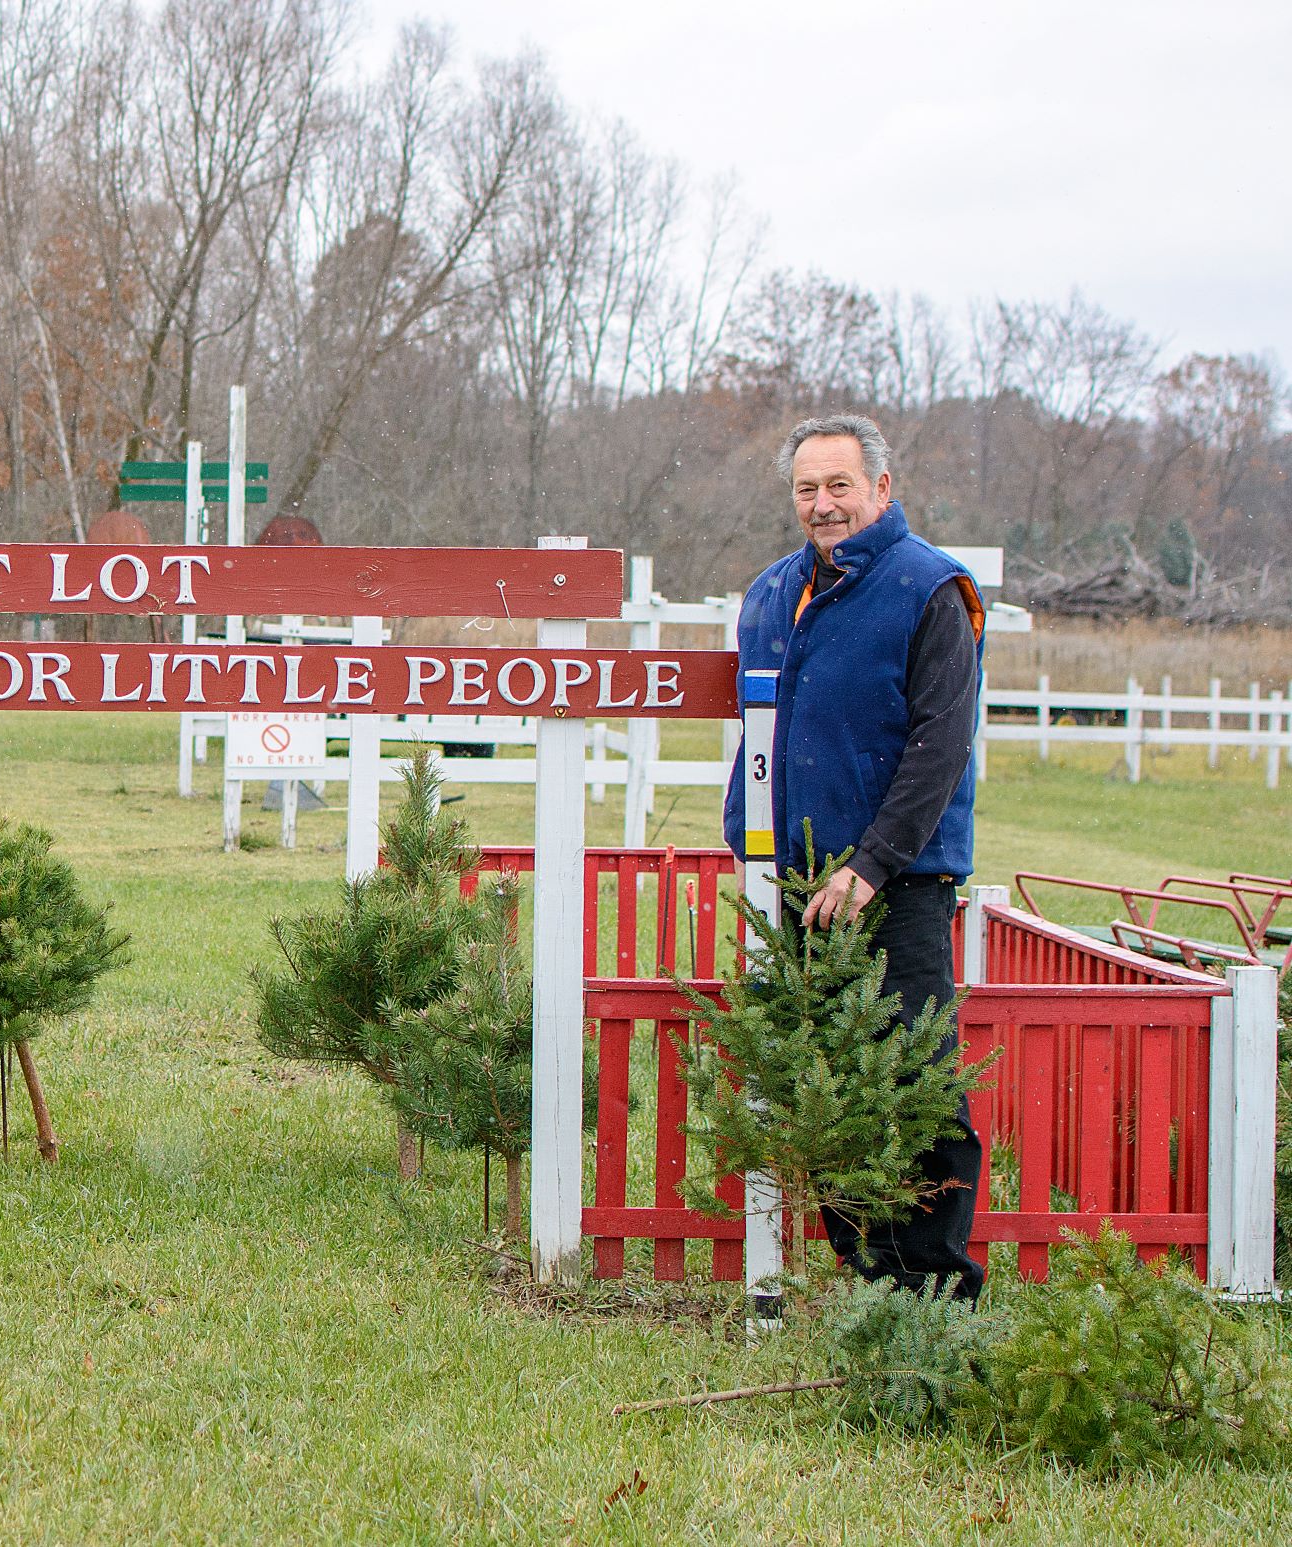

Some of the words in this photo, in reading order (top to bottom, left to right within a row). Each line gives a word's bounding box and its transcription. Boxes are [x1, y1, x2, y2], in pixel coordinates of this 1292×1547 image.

[49, 553, 211, 606] LOT
[99, 653, 376, 706] LITTLE
[404, 656, 685, 709] PEOPLE
[231, 712, 269, 722] WORK
[283, 713, 321, 722] AREA
[236, 755, 254, 764] NO
[267, 755, 316, 765] ENTRY
[753, 753, 768, 781] 3
